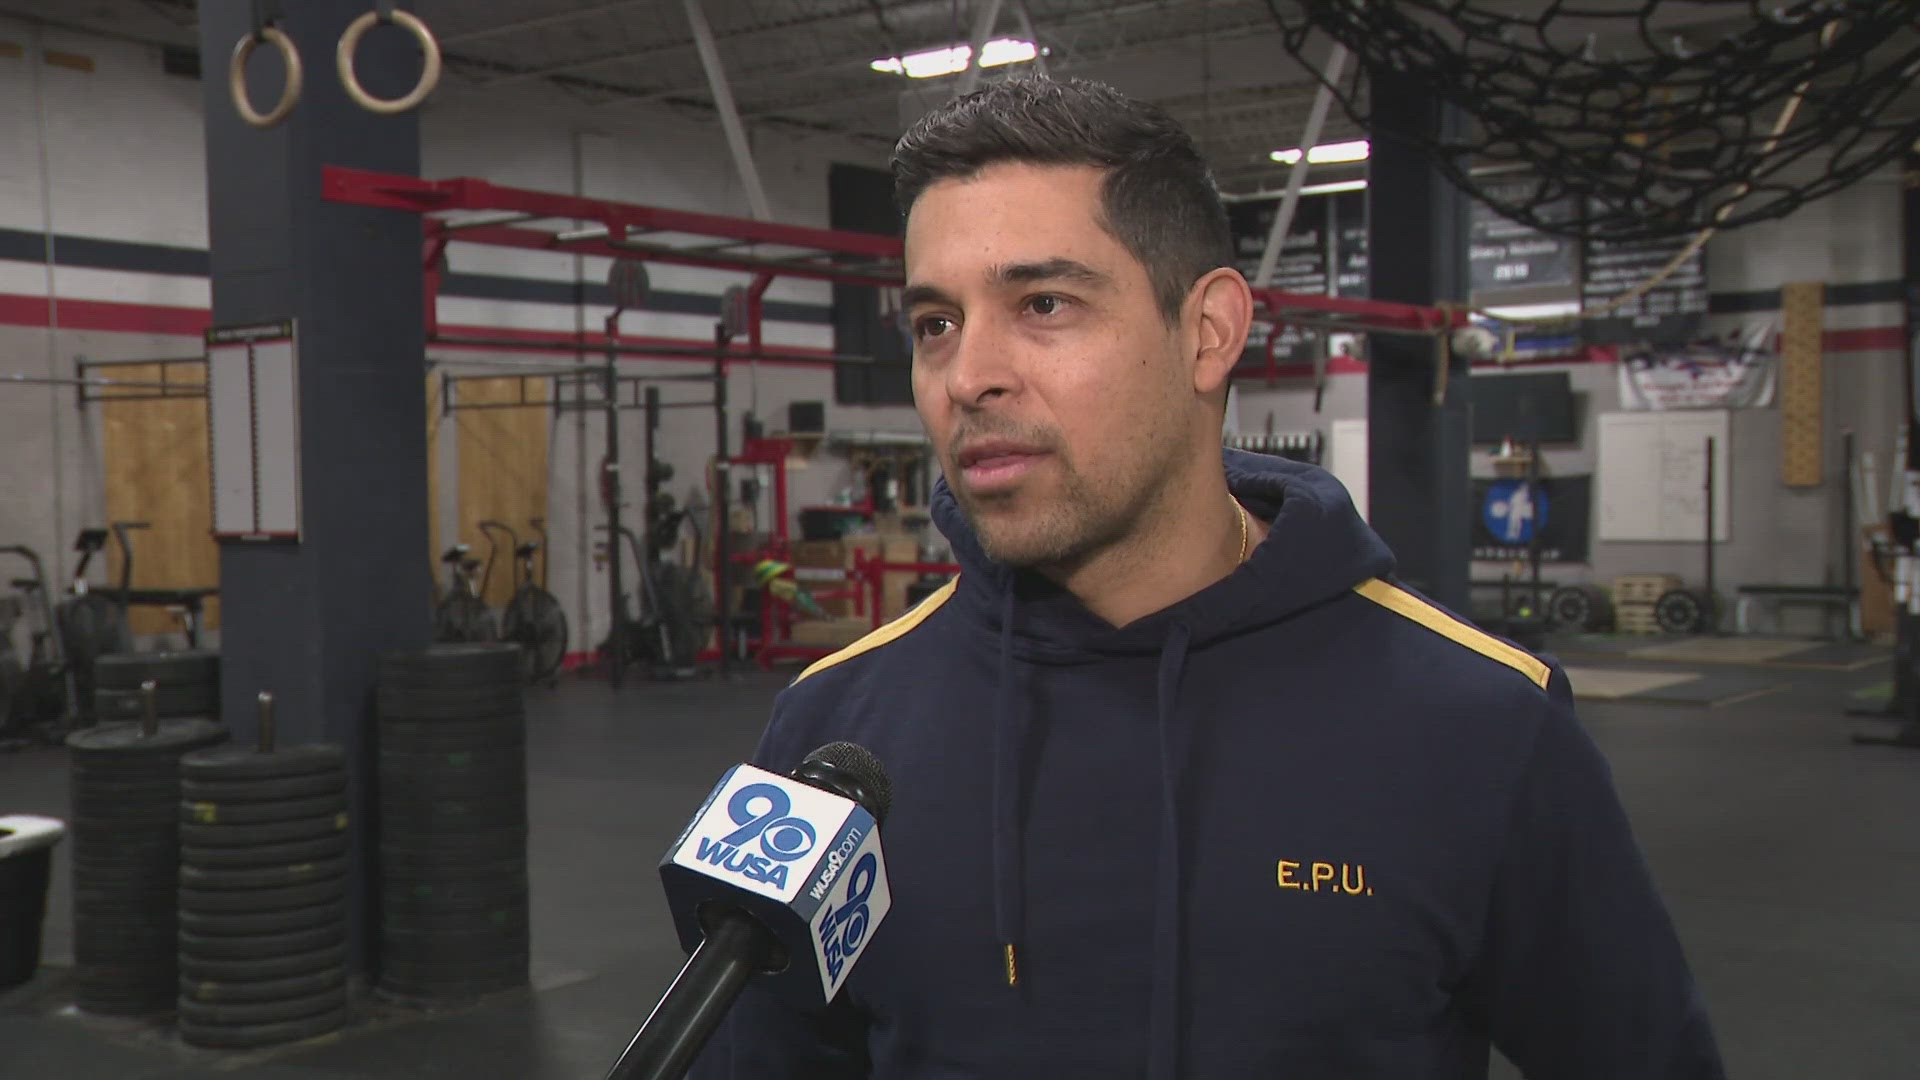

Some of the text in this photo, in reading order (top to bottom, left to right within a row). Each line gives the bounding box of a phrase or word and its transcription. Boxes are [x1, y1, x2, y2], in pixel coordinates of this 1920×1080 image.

[727, 783, 791, 848] 9
[696, 837, 789, 890] WUSA
[834, 852, 877, 926] 9
[1277, 859, 1374, 896] E.P.U.
[818, 904, 844, 989] WUSA
